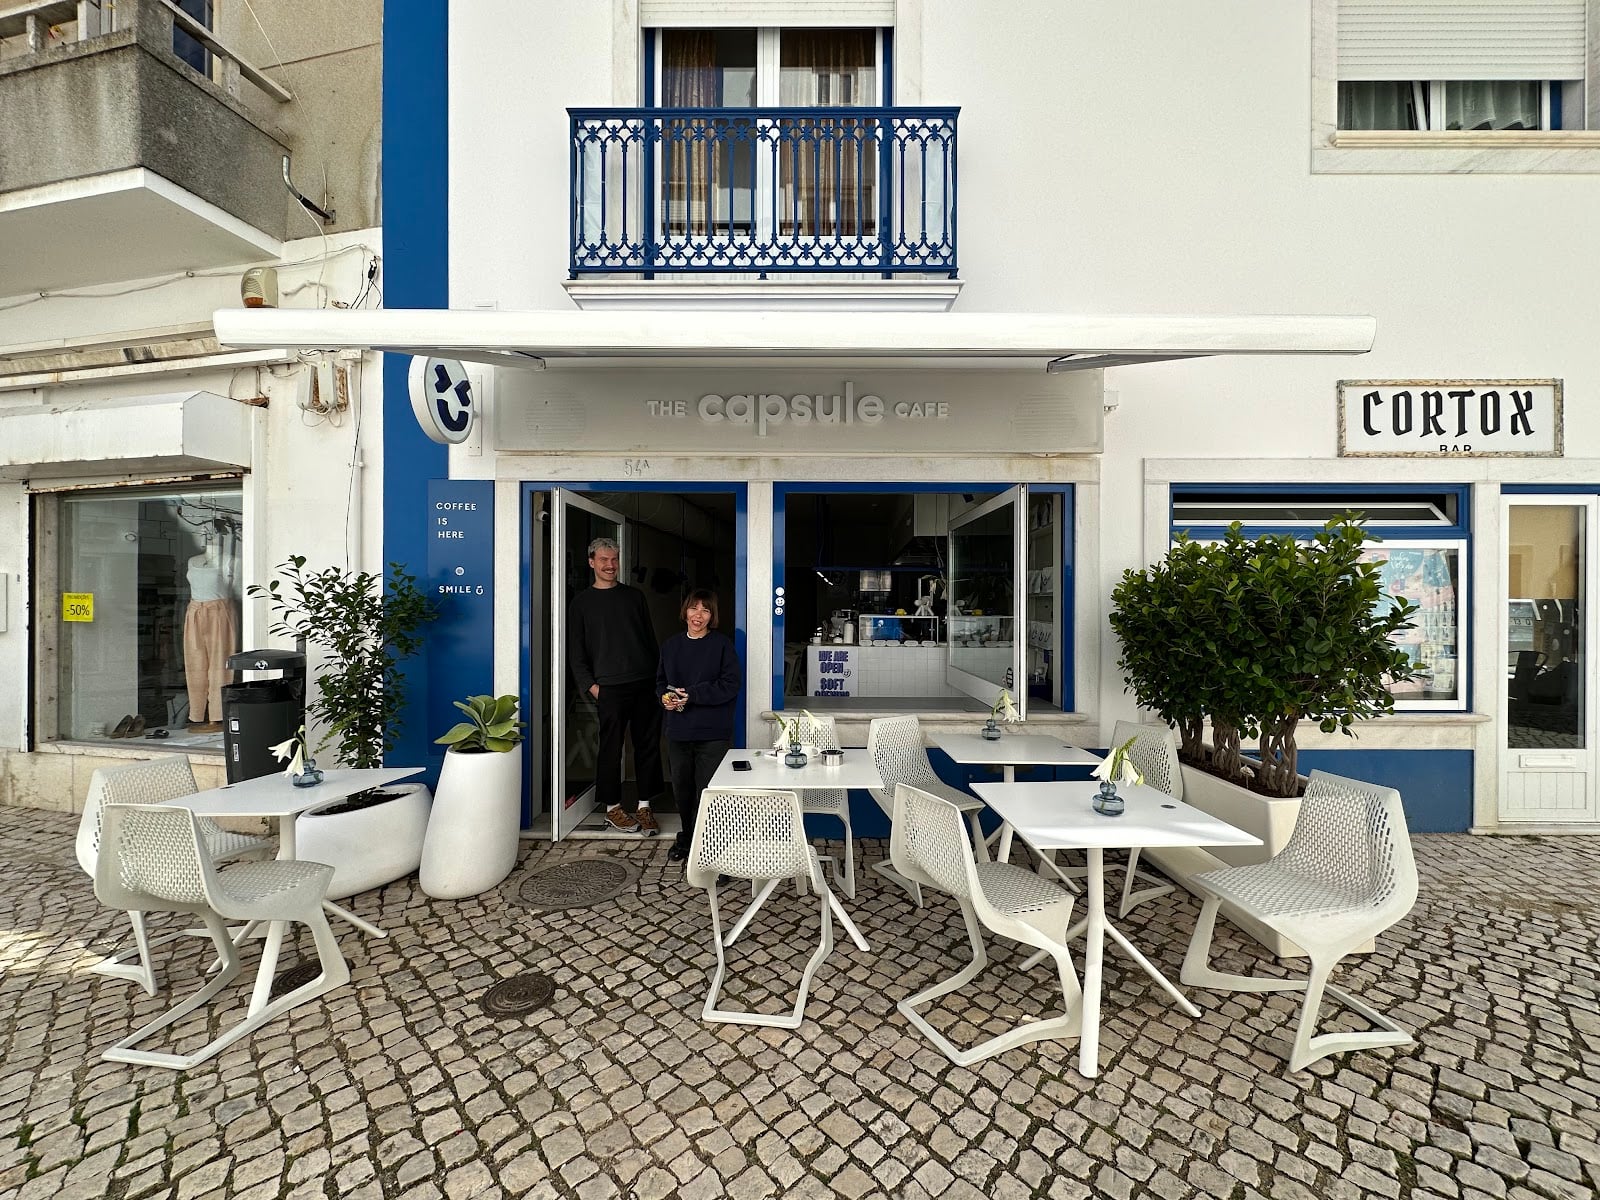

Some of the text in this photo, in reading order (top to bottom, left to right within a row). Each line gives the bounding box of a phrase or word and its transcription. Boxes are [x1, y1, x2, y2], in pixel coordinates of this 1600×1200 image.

[647, 381, 950, 436] THE capsule CAFE
[1362, 389, 1535, 438] CORTOX
[436, 502, 477, 511] COFFEE
[437, 517, 448, 526] IS
[437, 530, 465, 539] HERE
[438, 585, 472, 594] SMILE
[66, 604, 90, 616] -50%
[818, 650, 849, 661] WE ARE
[820, 661, 844, 673] OPEN
[820, 678, 844, 690] SOFT
